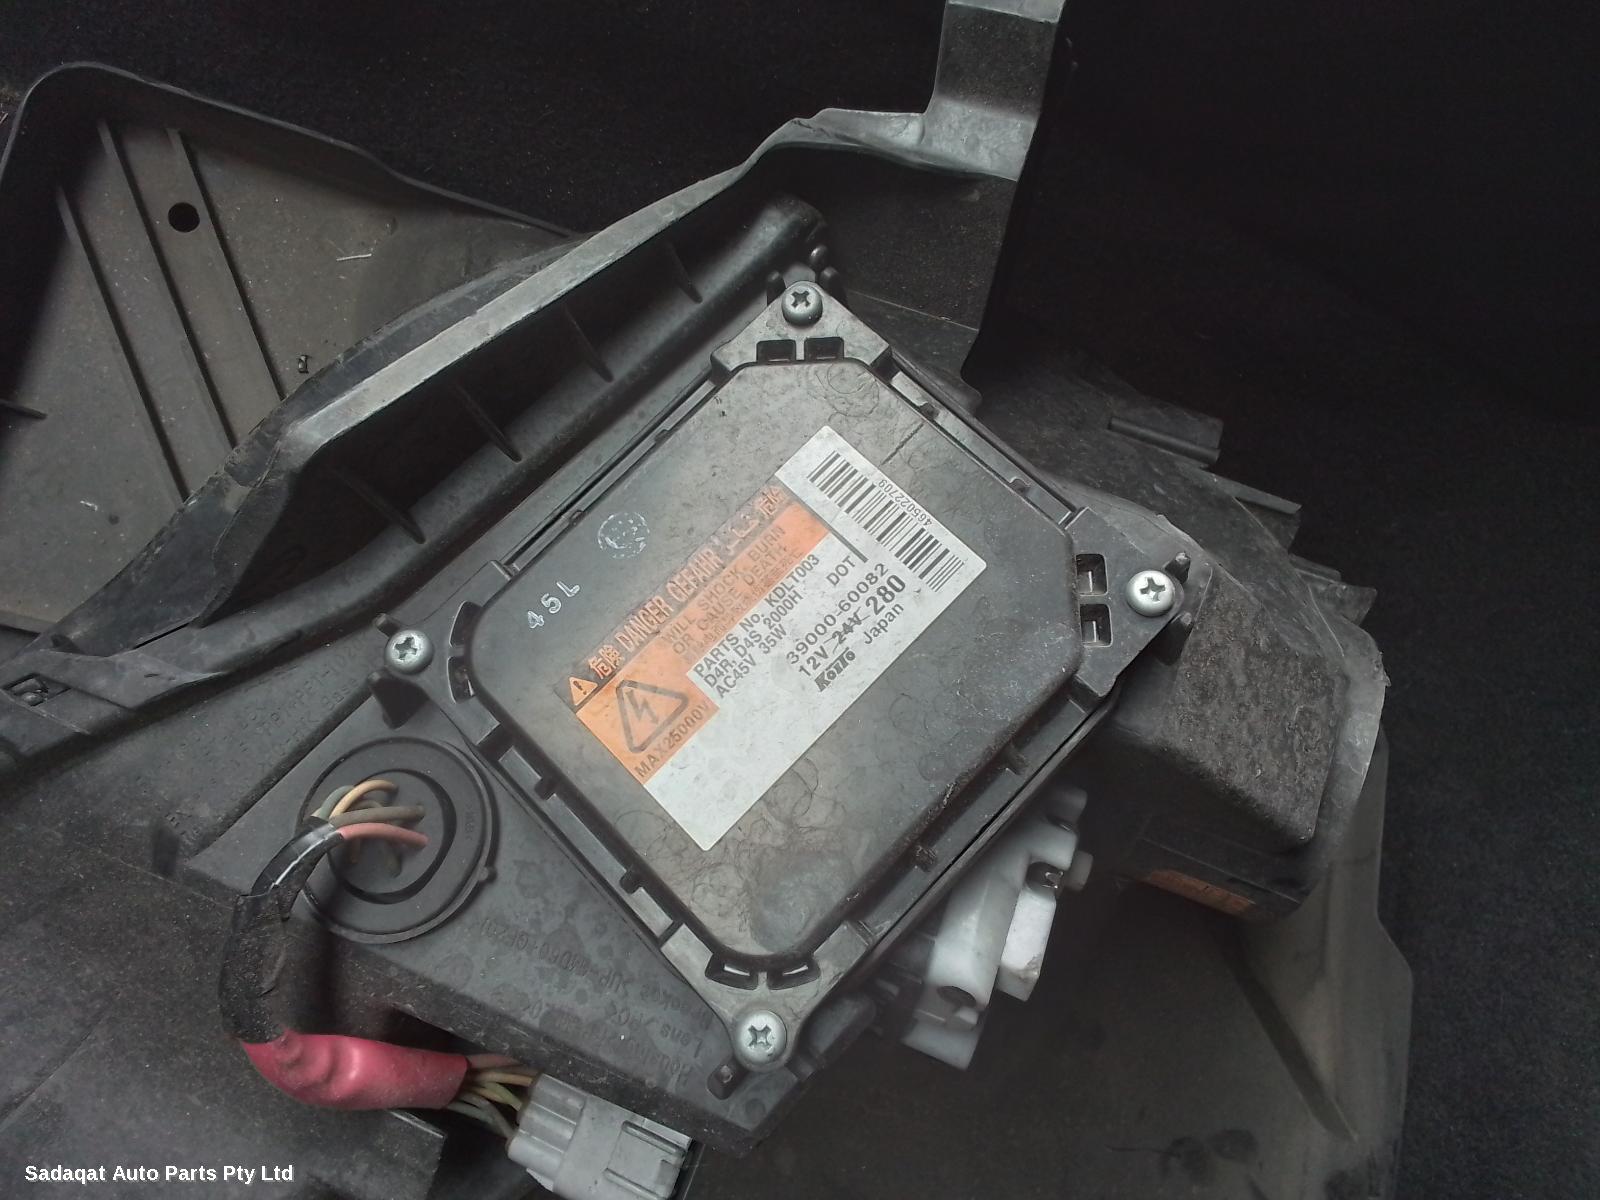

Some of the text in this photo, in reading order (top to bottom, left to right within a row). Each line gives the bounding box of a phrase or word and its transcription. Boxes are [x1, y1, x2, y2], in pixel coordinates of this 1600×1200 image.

[877, 477, 933, 527] 465022709
[613, 541, 724, 652] DANGER GEFAHR
[660, 609, 697, 646] WILL
[747, 523, 786, 563] BURN
[671, 631, 695, 656] OR
[695, 586, 741, 632] CAUSE
[693, 551, 820, 678] PARTS No. KDLT003
[784, 560, 890, 666] 39000-60082
[825, 554, 857, 587] DOT
[703, 588, 803, 689] D4R, D4S 2000H
[717, 623, 788, 699] AC45V 35W
[797, 645, 830, 679] 12V
[863, 571, 907, 616] 280
[859, 601, 905, 645] Japan
